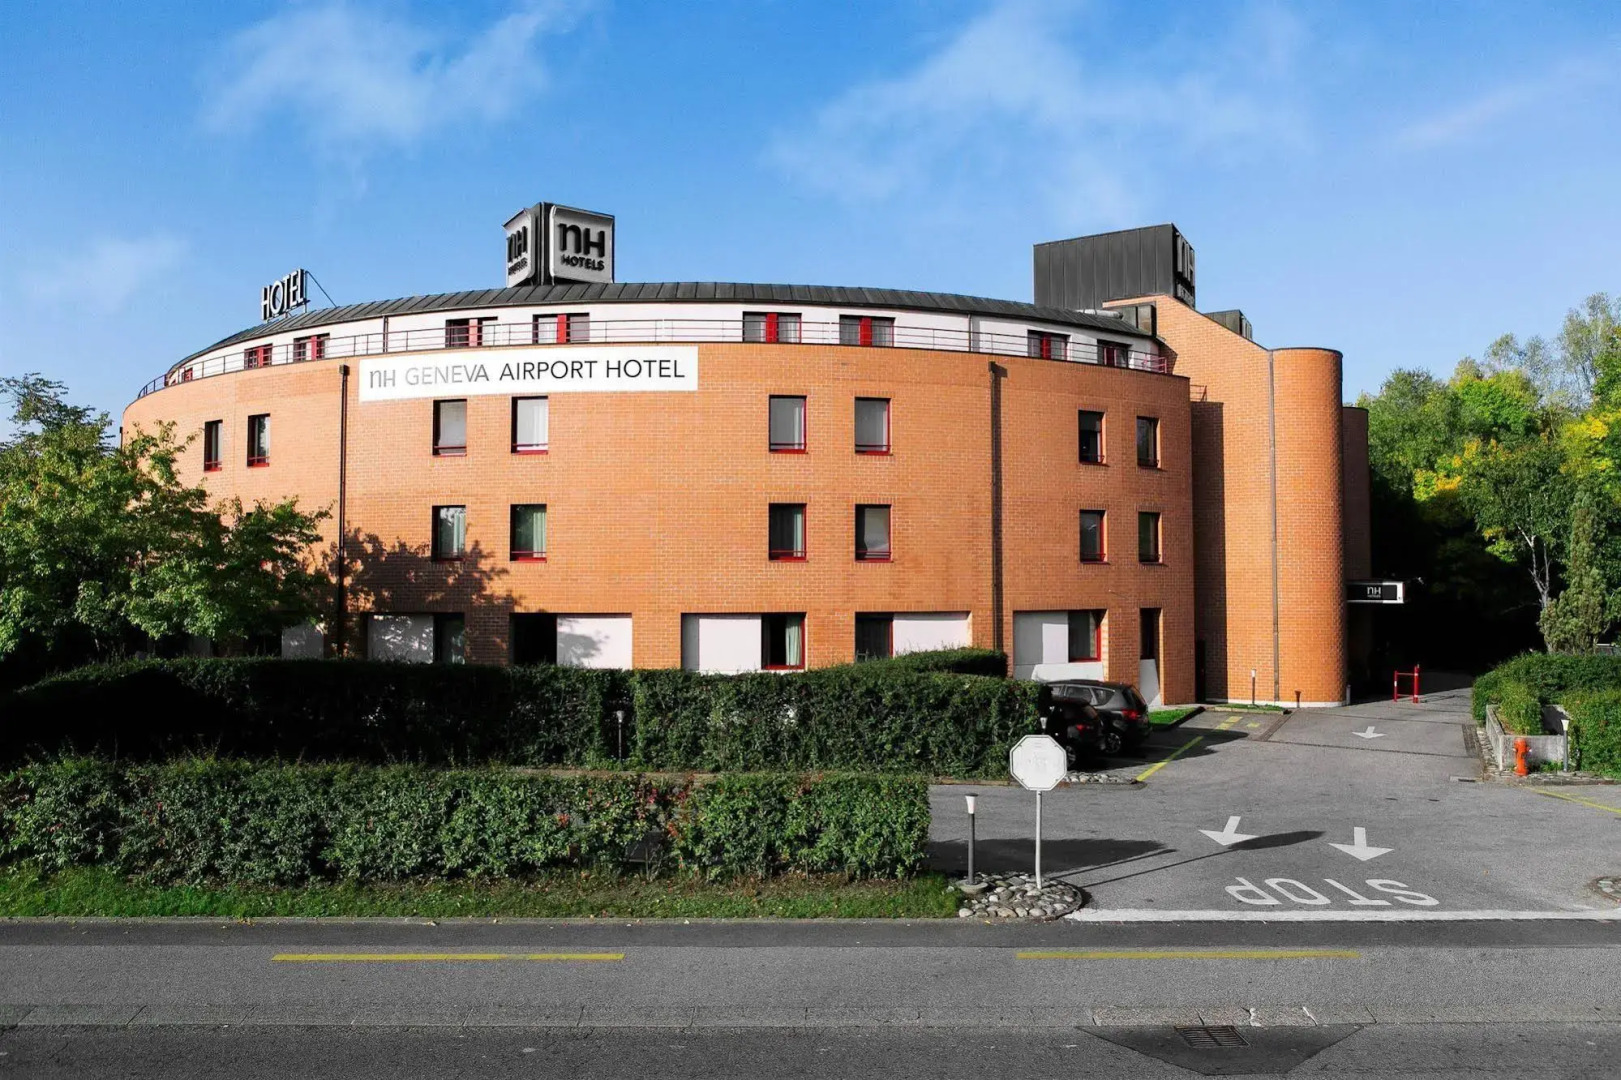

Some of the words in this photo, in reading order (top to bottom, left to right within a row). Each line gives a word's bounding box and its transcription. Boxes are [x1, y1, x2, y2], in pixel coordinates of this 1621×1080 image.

[561, 254, 605, 271] HOTELS
[261, 268, 304, 320] HOTEL
[405, 364, 489, 386] GENEVA
[499, 360, 598, 381] AIRPORT
[606, 359, 685, 379] HOTEL
[1225, 877, 1440, 906] STOP
